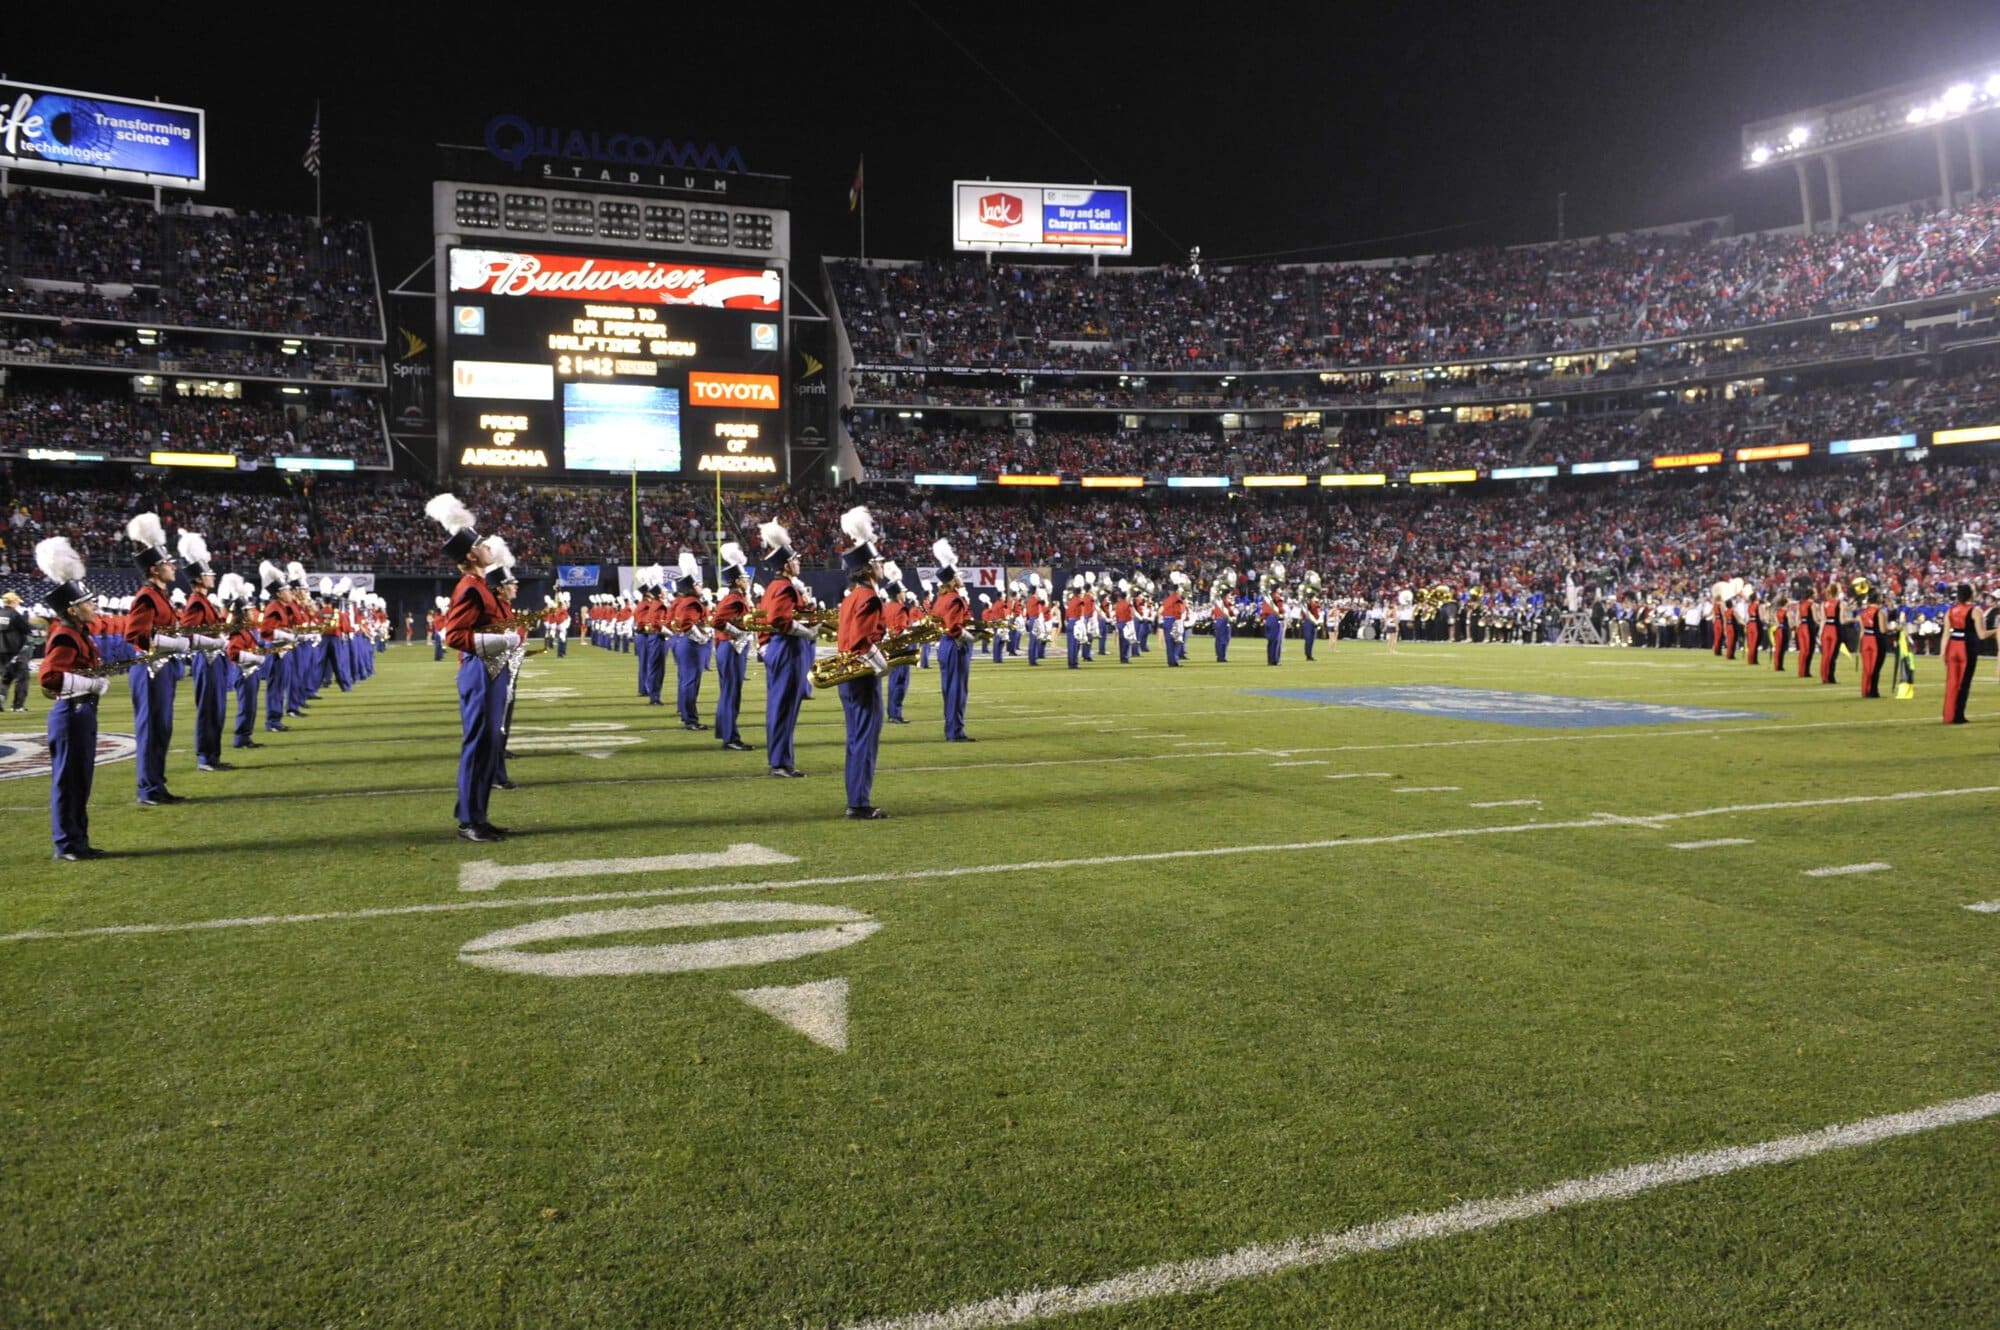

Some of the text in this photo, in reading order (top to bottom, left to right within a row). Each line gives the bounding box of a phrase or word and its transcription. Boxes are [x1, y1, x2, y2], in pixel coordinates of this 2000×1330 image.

[0, 93, 44, 154] ife
[94, 113, 191, 139] Transforming
[116, 130, 170, 146] science
[484, 114, 748, 174] QUALCOMM
[20, 140, 112, 162] technologies
[543, 164, 727, 191] STADIUM
[981, 196, 1022, 224] Jack
[1059, 207, 1111, 219] Buy and Sell
[1048, 219, 1122, 231] Chargers Tickets!
[485, 253, 706, 296] Budweiser
[573, 318, 668, 338] DR PEPPER
[548, 334, 642, 354] HALFTIME
[393, 362, 432, 378] Sprint
[693, 382, 776, 401] TOYOTA
[793, 382, 827, 396] Sprint
[480, 414, 529, 431] PRIDE
[715, 422, 760, 438] PRIDE
[493, 432, 517, 446] OF
[727, 439, 748, 453] OF
[460, 448, 549, 468] ARIZONA
[697, 455, 777, 473] ARIZONA
[979, 569, 998, 586] N
